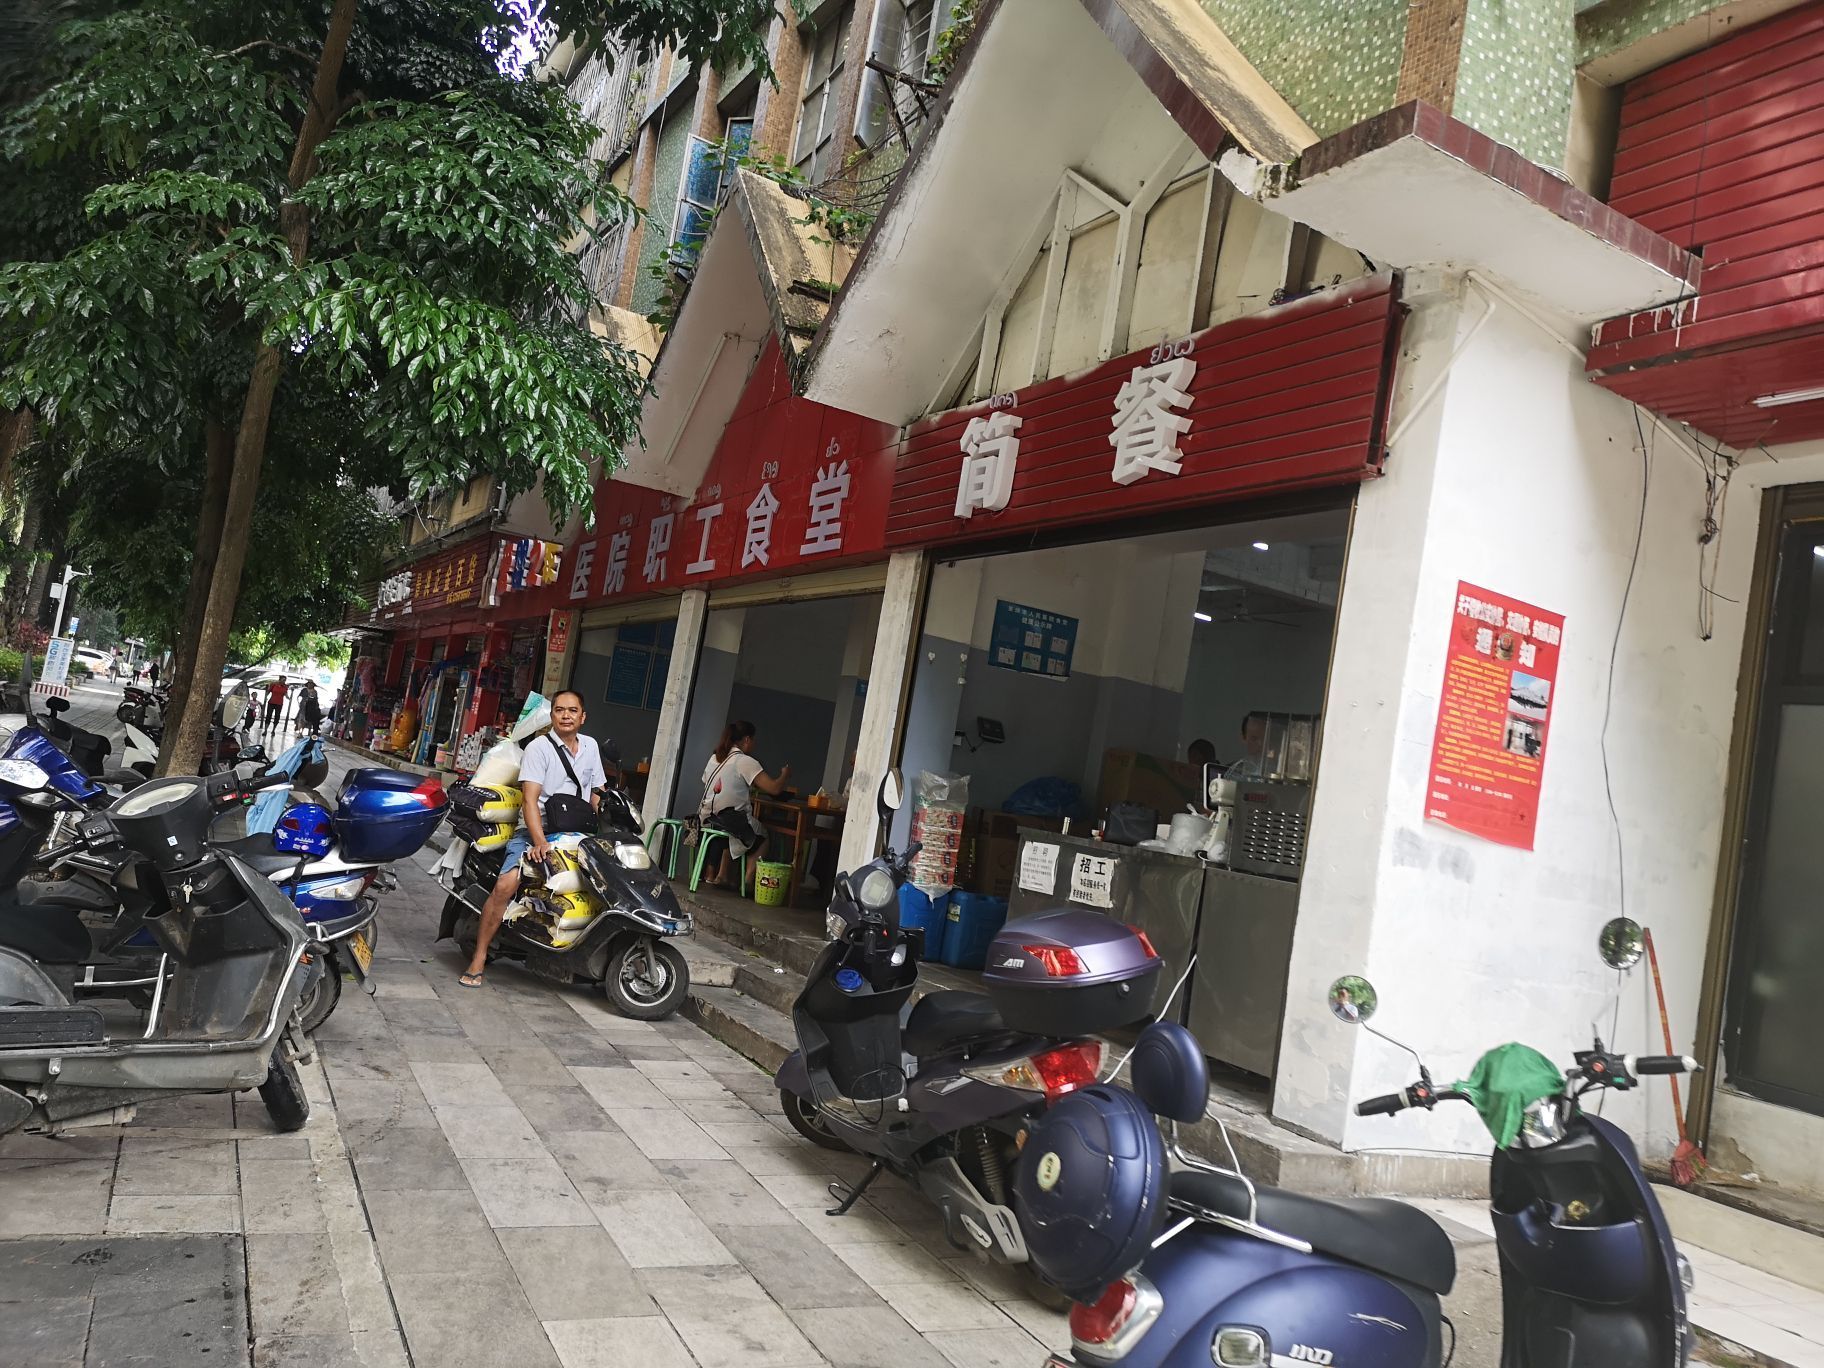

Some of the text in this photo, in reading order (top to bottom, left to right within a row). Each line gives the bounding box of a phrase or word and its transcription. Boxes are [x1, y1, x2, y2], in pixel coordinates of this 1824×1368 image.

[954, 357, 1196, 519] 简餐
[568, 459, 852, 600] 医院职工食堂
[1079, 857, 1107, 876] 招工
